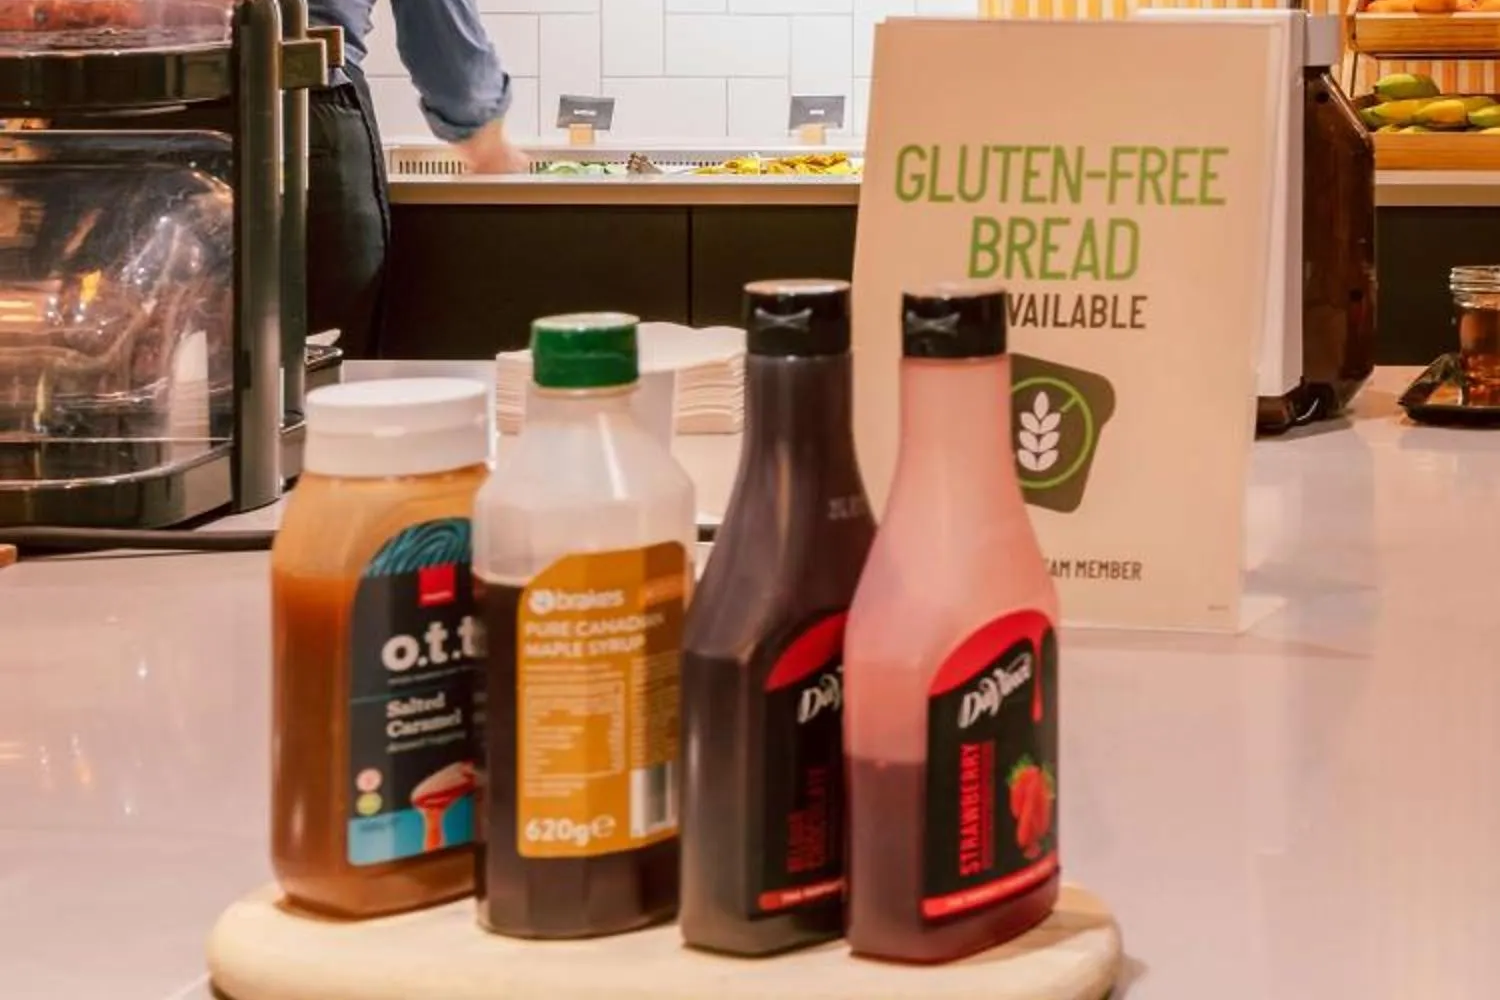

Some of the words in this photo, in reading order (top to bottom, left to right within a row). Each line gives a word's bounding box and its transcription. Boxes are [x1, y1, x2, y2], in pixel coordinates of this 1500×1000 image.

[894, 143, 1230, 206] GLUTEN-FREE
[967, 215, 1141, 281] BREAD
[1006, 292, 1148, 329] VAILABLE
[1074, 559, 1142, 582] MEMBER
[525, 639, 582, 658] MAPLE
[386, 690, 446, 718] Salted
[959, 742, 982, 877] STRAWBERRY
